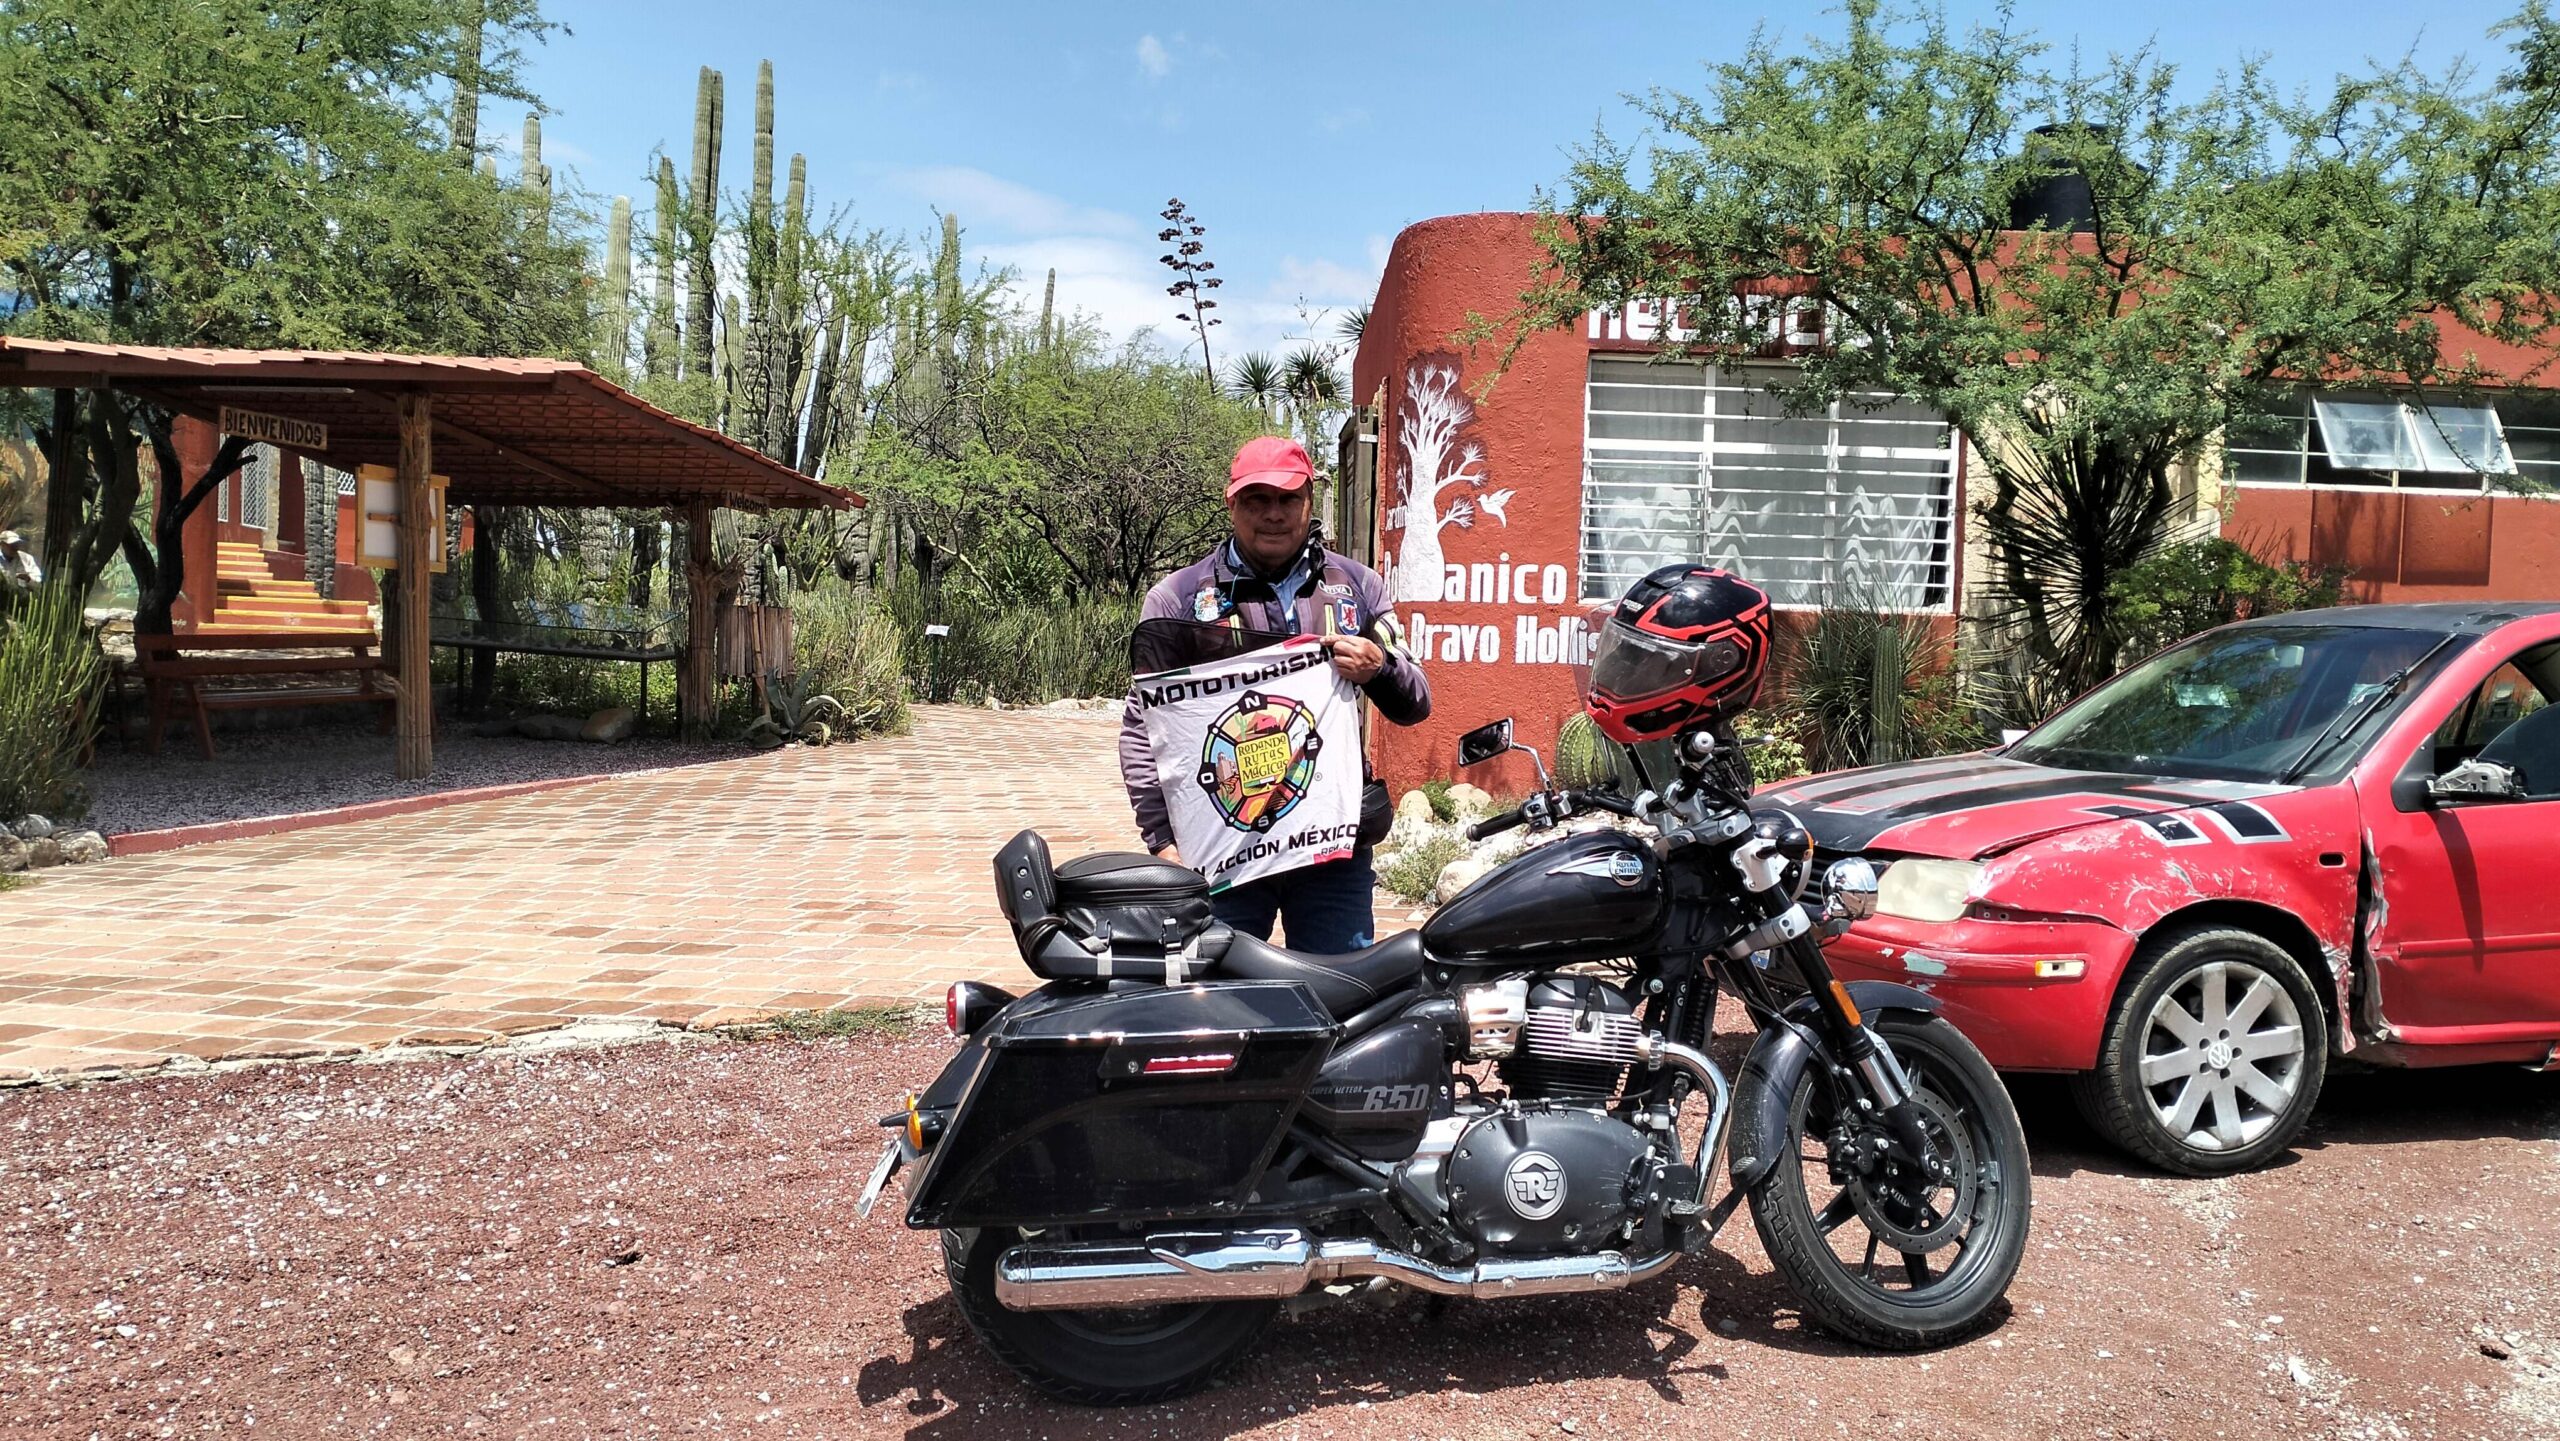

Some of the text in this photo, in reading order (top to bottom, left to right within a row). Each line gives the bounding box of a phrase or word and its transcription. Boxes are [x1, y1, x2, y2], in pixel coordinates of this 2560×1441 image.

[224, 408, 323, 446] BIENVENIDOS
[1410, 612, 1501, 664] Bravo
[1140, 646, 1336, 709] MOTOTURISM
[1244, 695, 1261, 709] N
[1213, 838, 1280, 877] ACCIÓN
[1334, 1085, 1363, 1095] METEOR
[1362, 1083, 1430, 1112] 650
